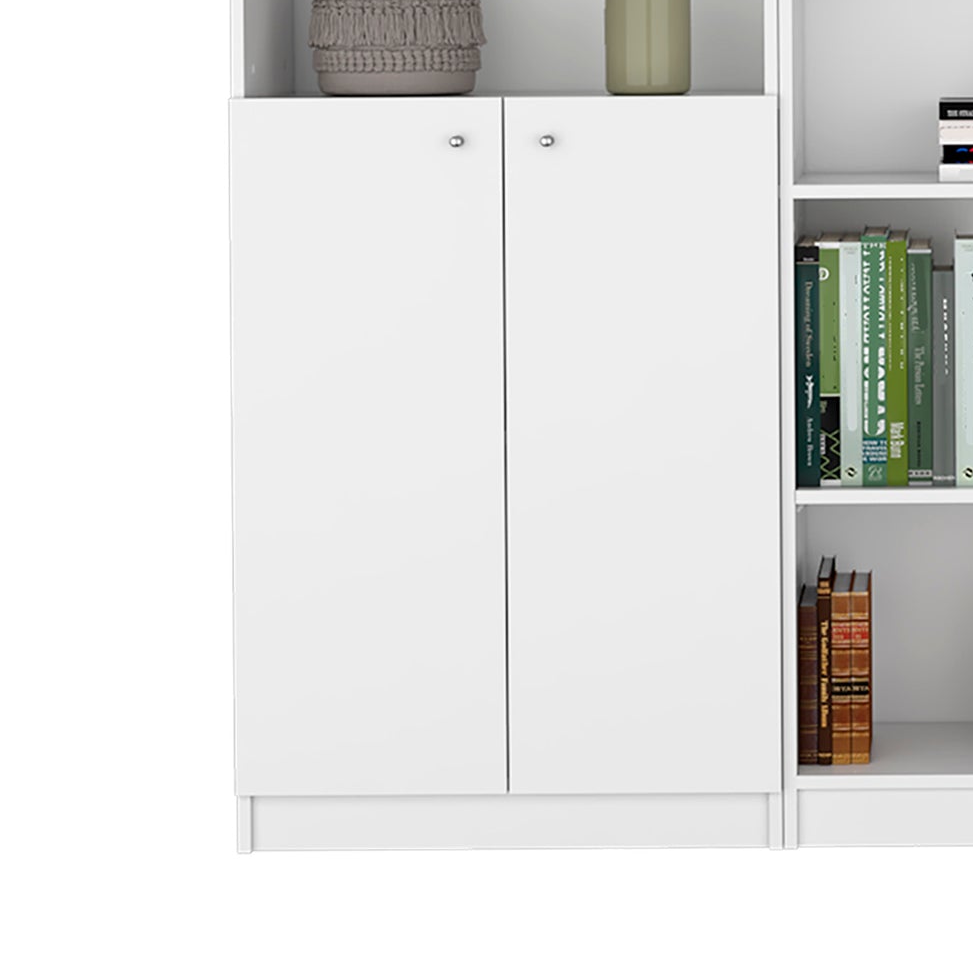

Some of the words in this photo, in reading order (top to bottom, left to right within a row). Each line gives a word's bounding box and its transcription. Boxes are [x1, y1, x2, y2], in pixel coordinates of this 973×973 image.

[803, 281, 814, 323] Dreaming
[805, 324, 814, 333] of
[804, 334, 814, 367] Sweden
[914, 346, 925, 359] The
[806, 417, 814, 443] Andrew
[890, 422, 904, 439] Mark
[806, 444, 814, 466] Brown
